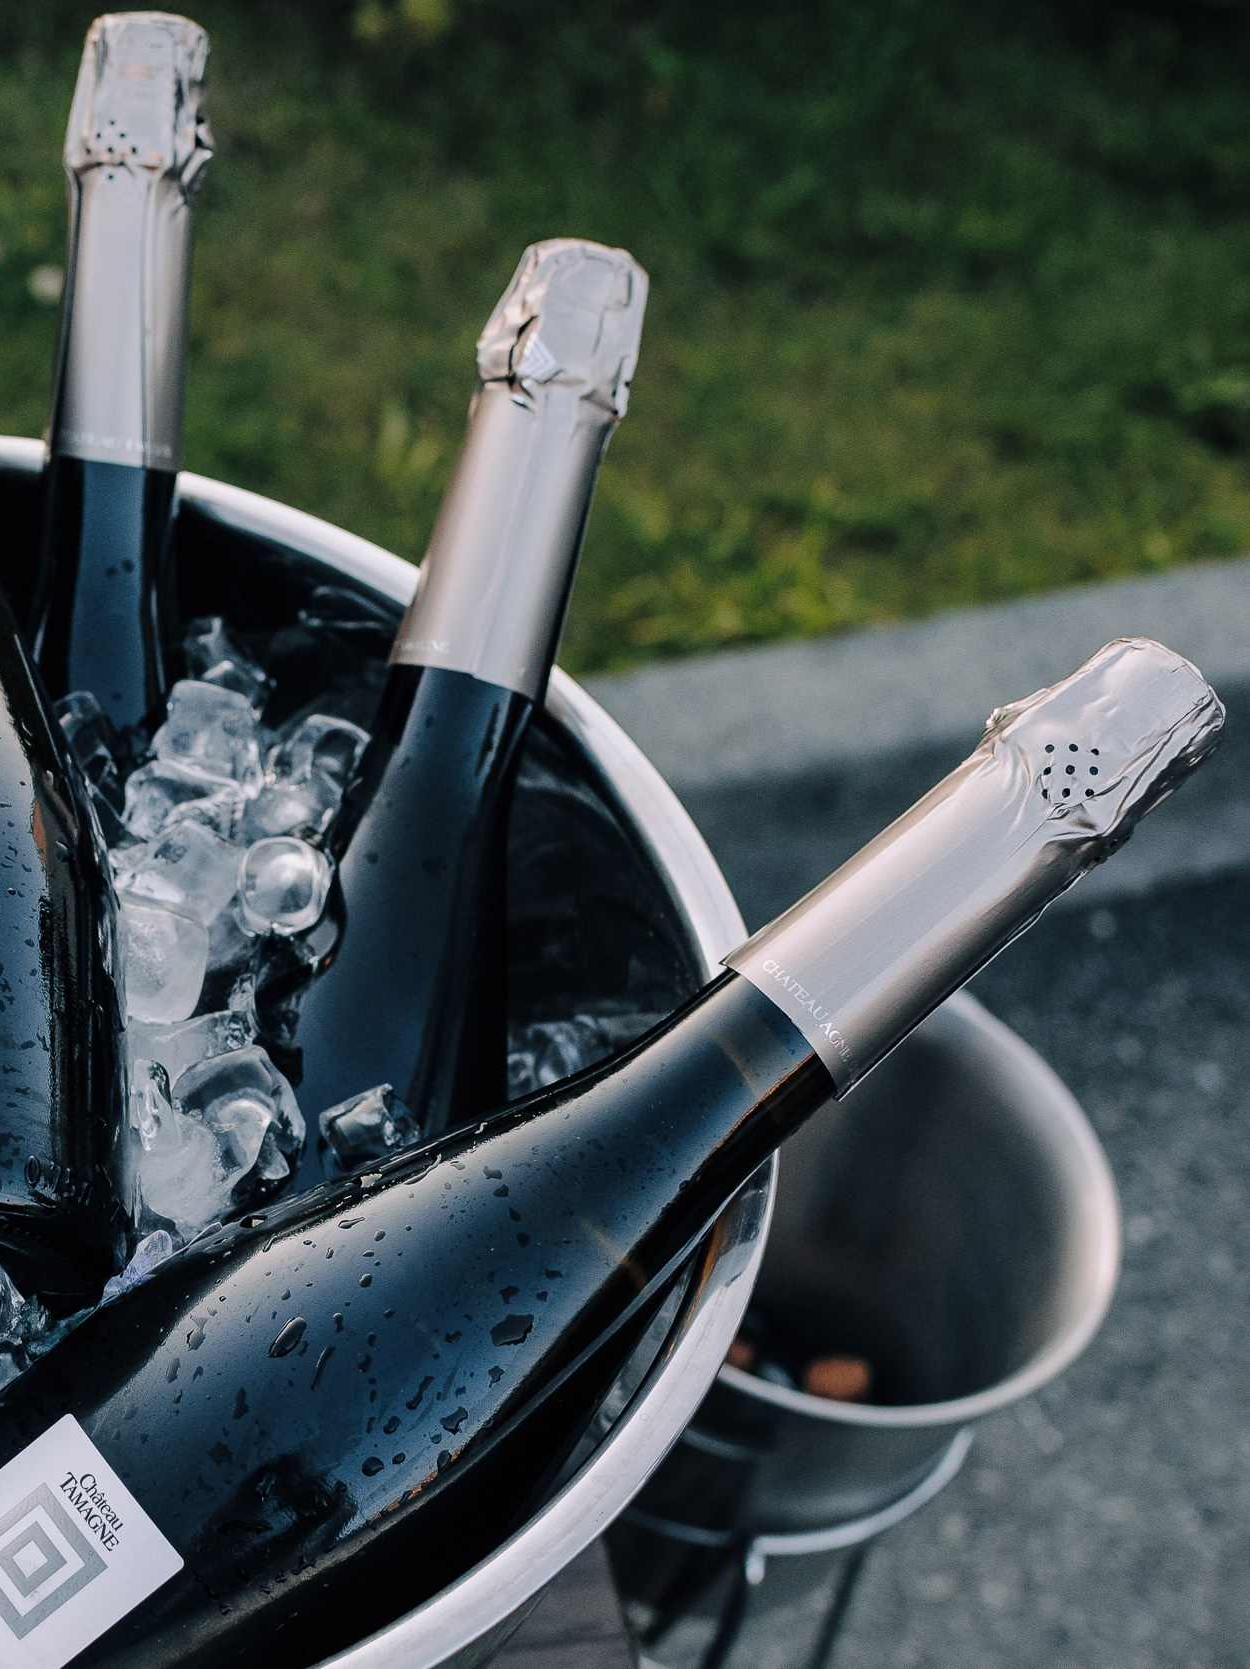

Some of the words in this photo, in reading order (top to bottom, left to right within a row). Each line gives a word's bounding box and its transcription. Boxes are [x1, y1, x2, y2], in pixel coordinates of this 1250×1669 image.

[761, 959, 829, 1021] CHATEAU
[58, 1471, 120, 1552] TAMAGNE
[79, 1472, 124, 1532] Château
